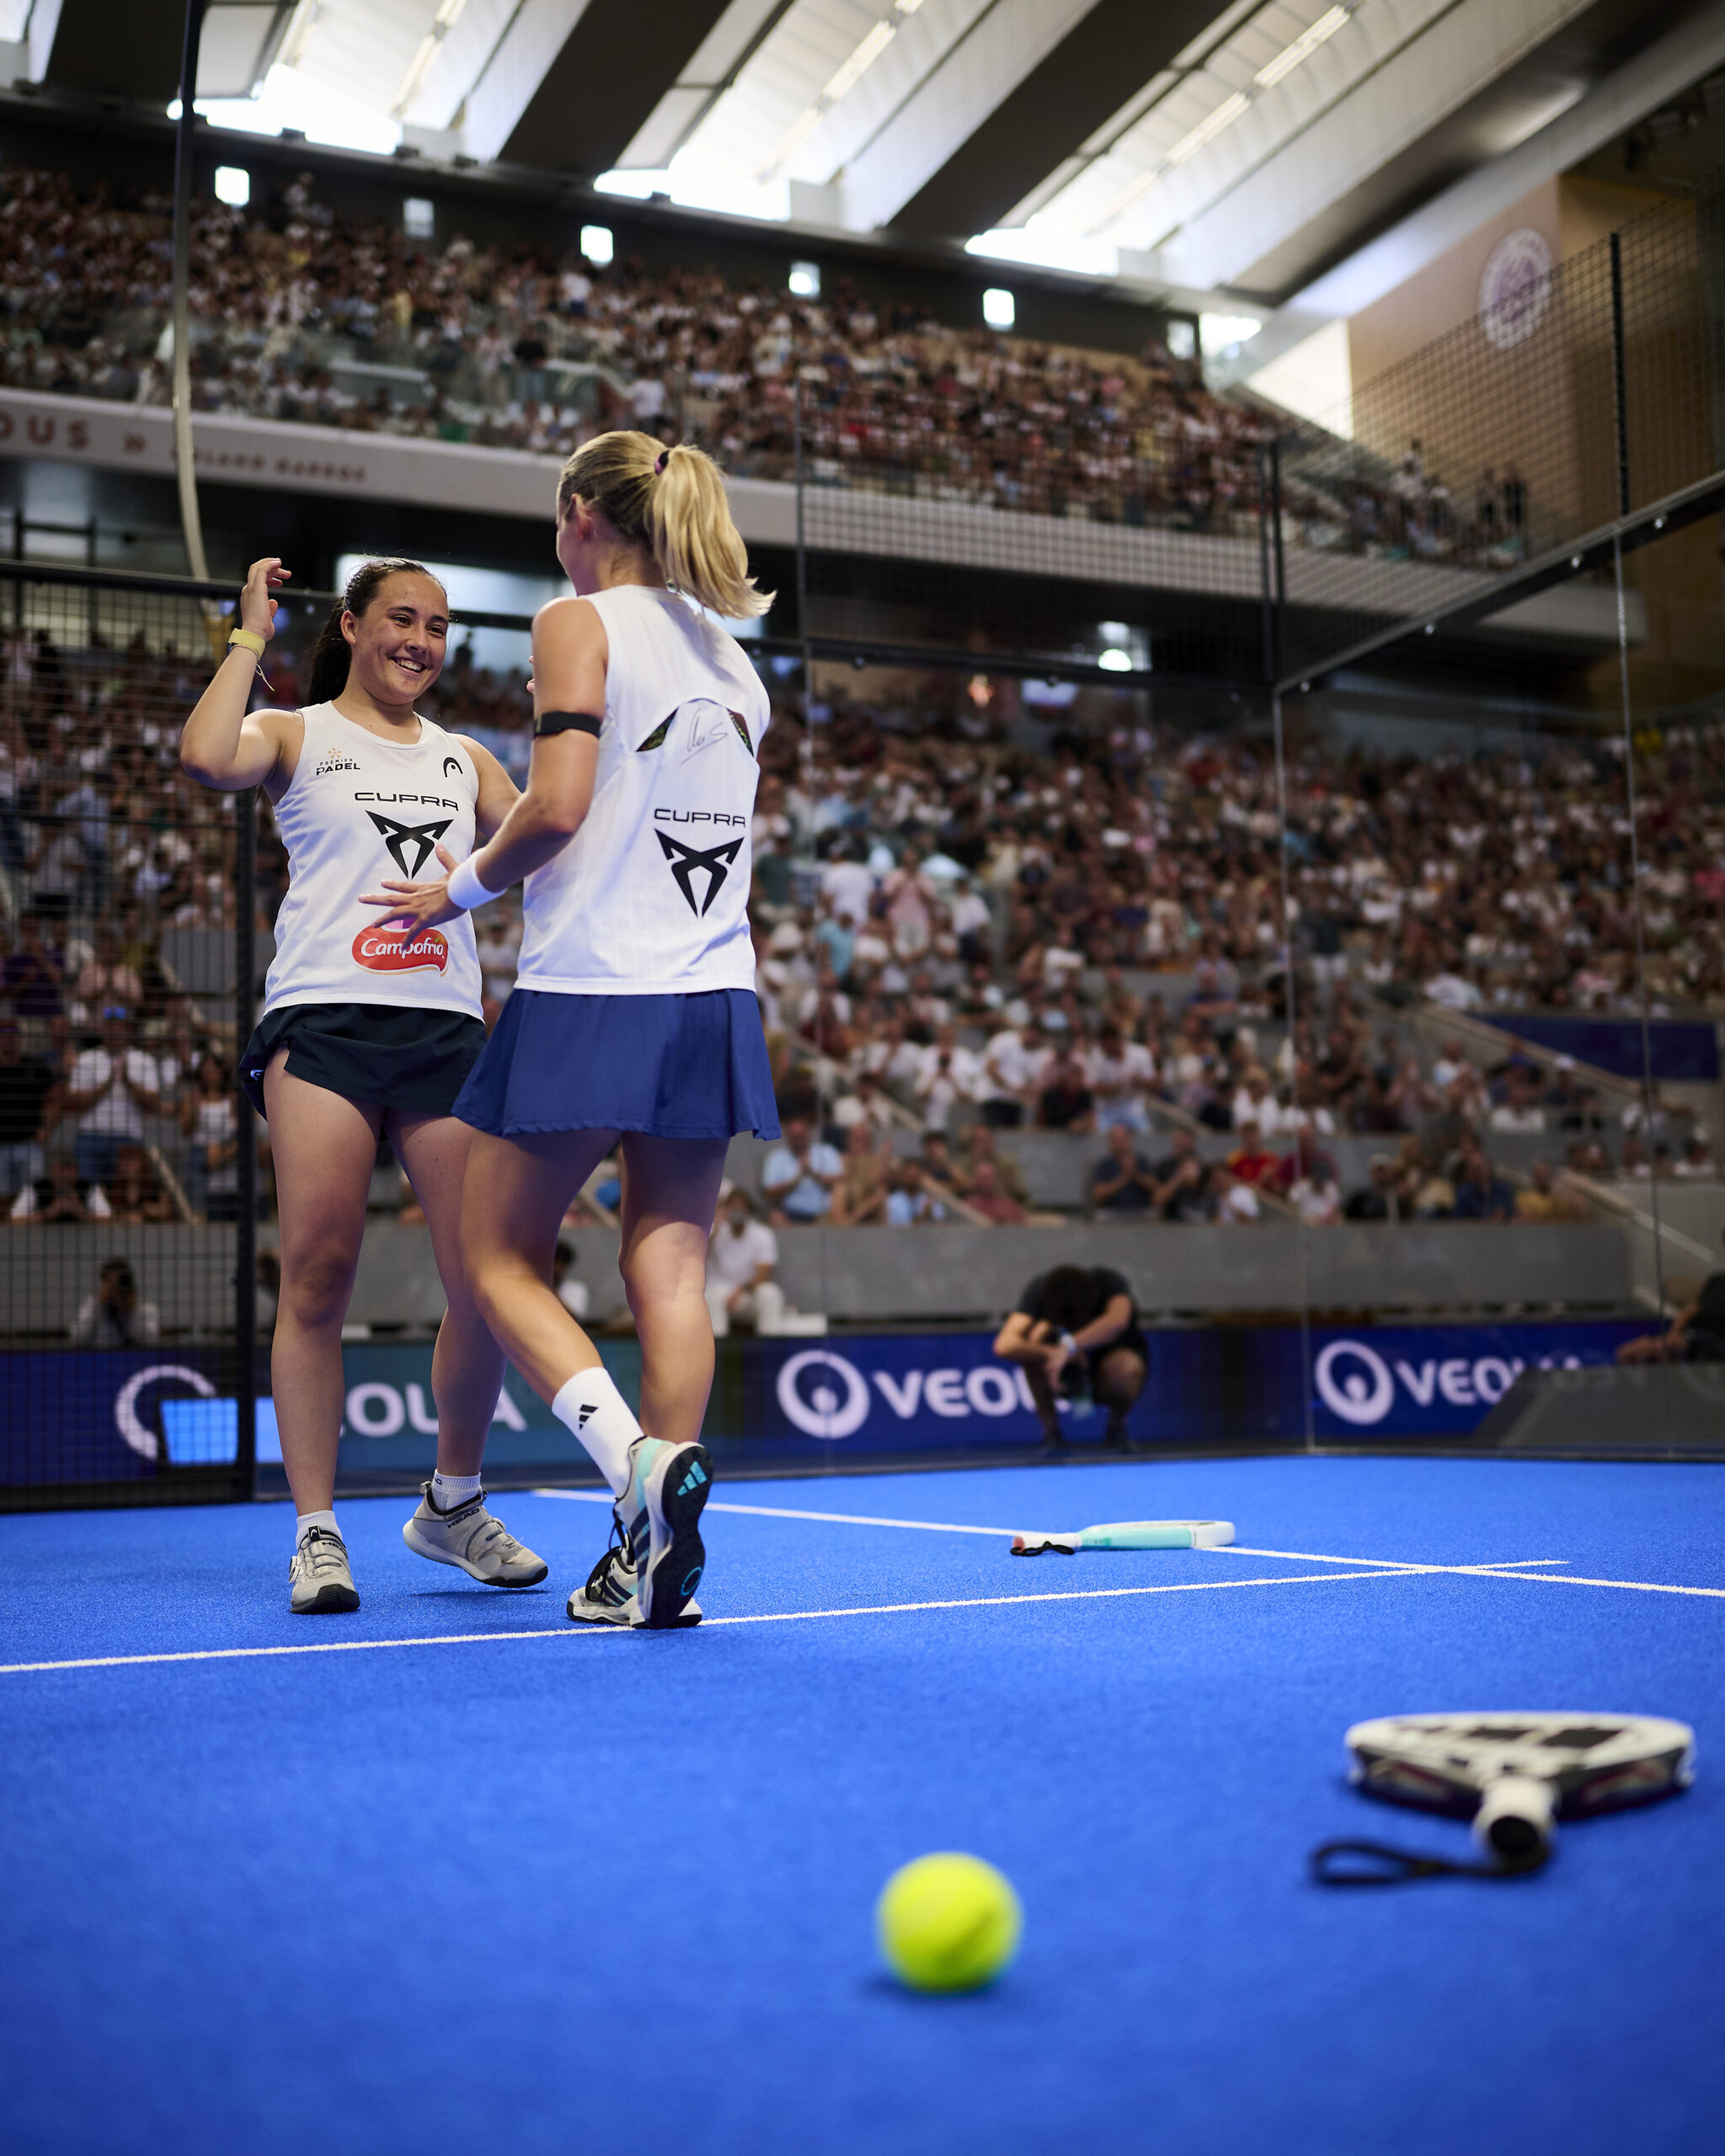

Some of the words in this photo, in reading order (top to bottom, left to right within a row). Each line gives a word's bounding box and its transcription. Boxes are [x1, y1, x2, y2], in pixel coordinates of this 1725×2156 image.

[316, 762, 360, 776] PADEL
[319, 758, 353, 766] PREMIER
[355, 792, 459, 812] CUPRA
[654, 808, 746, 828] CUPRA
[1391, 1355, 1582, 1407] VEO
[446, 1508, 480, 1529] HEAD
